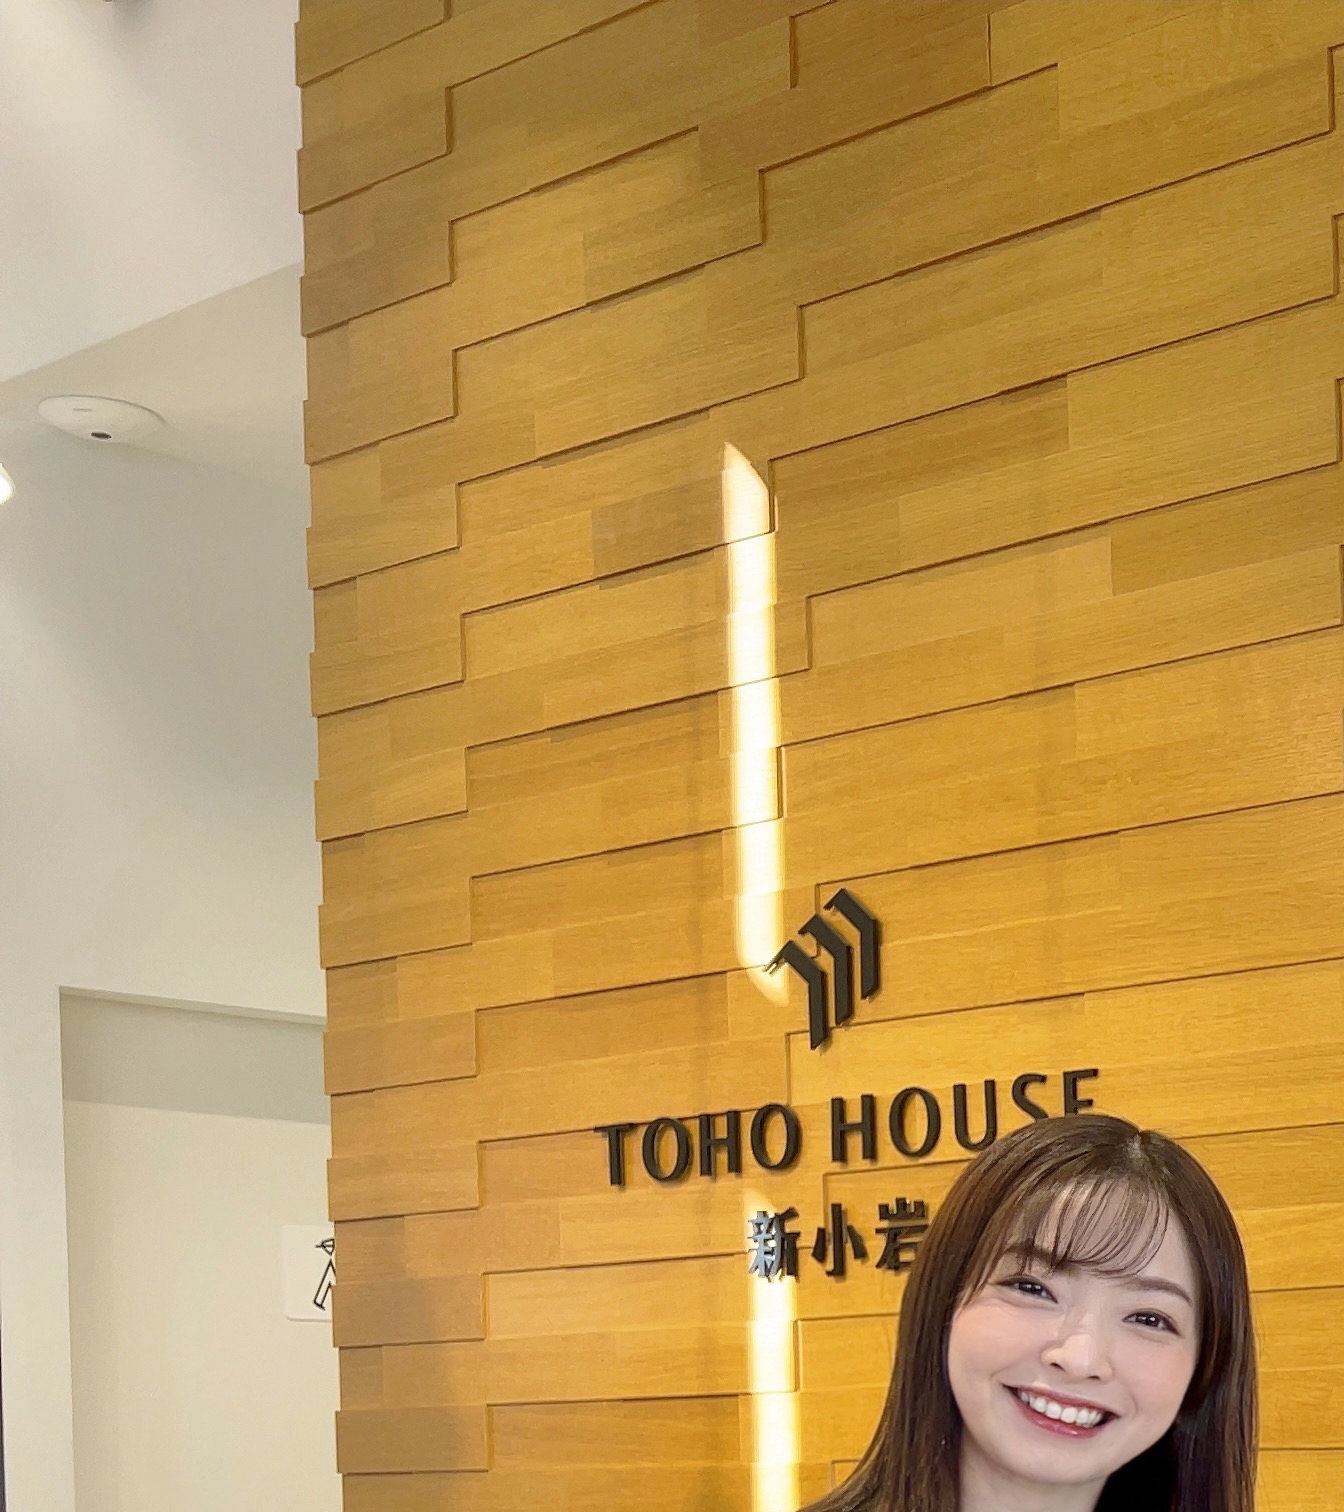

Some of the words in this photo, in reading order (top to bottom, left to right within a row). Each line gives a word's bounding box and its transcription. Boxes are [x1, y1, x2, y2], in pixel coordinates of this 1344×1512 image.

[594, 1102, 802, 1188] TOHO
[830, 1067, 1099, 1164] HOUSE
[746, 1196, 929, 1283] 新小岩
